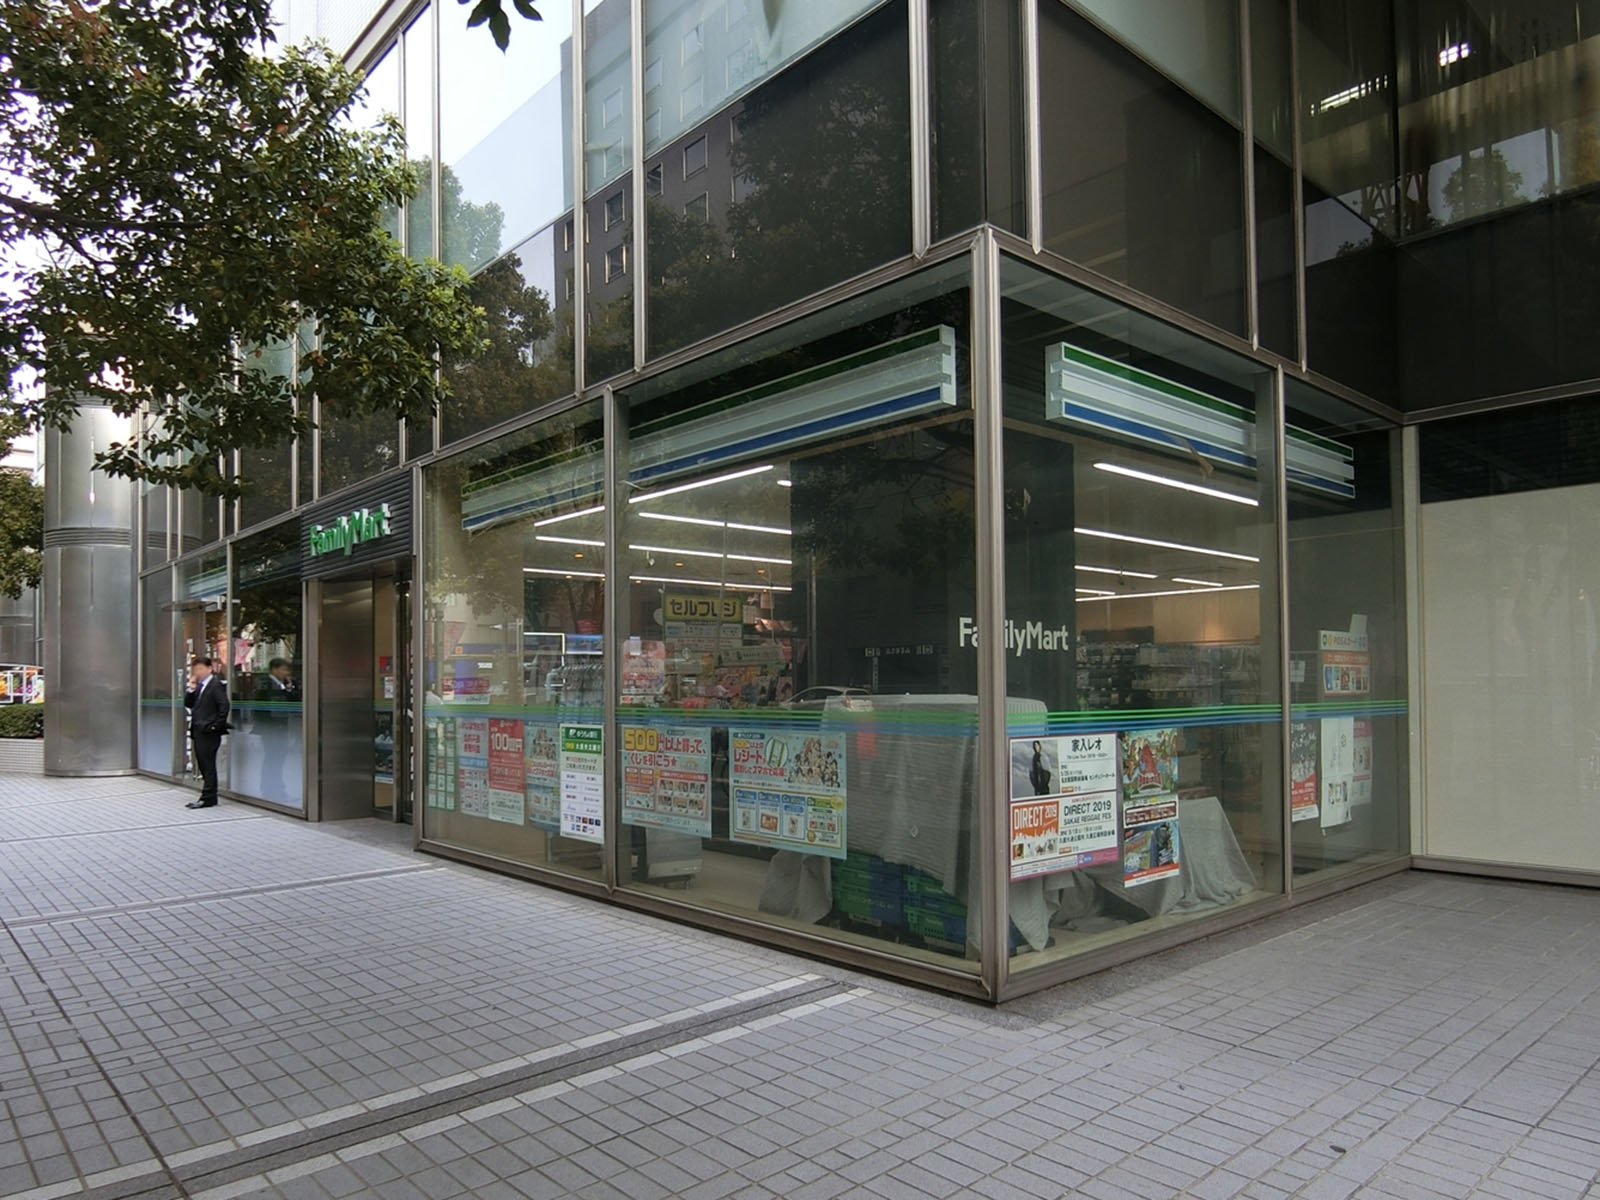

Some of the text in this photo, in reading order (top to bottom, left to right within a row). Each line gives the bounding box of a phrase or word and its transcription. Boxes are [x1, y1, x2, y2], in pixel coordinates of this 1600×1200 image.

[310, 503, 391, 556] FamilyMart
[670, 598, 737, 618] セルフレジ
[959, 616, 1069, 657] FailyMart
[1071, 737, 1102, 752] 家入レオ
[1014, 806, 1044, 830] DIRECT
[1063, 800, 1112, 816] DIRECT 2019
[1063, 816, 1080, 826] SAKAE
[1102, 812, 1112, 820] FES
